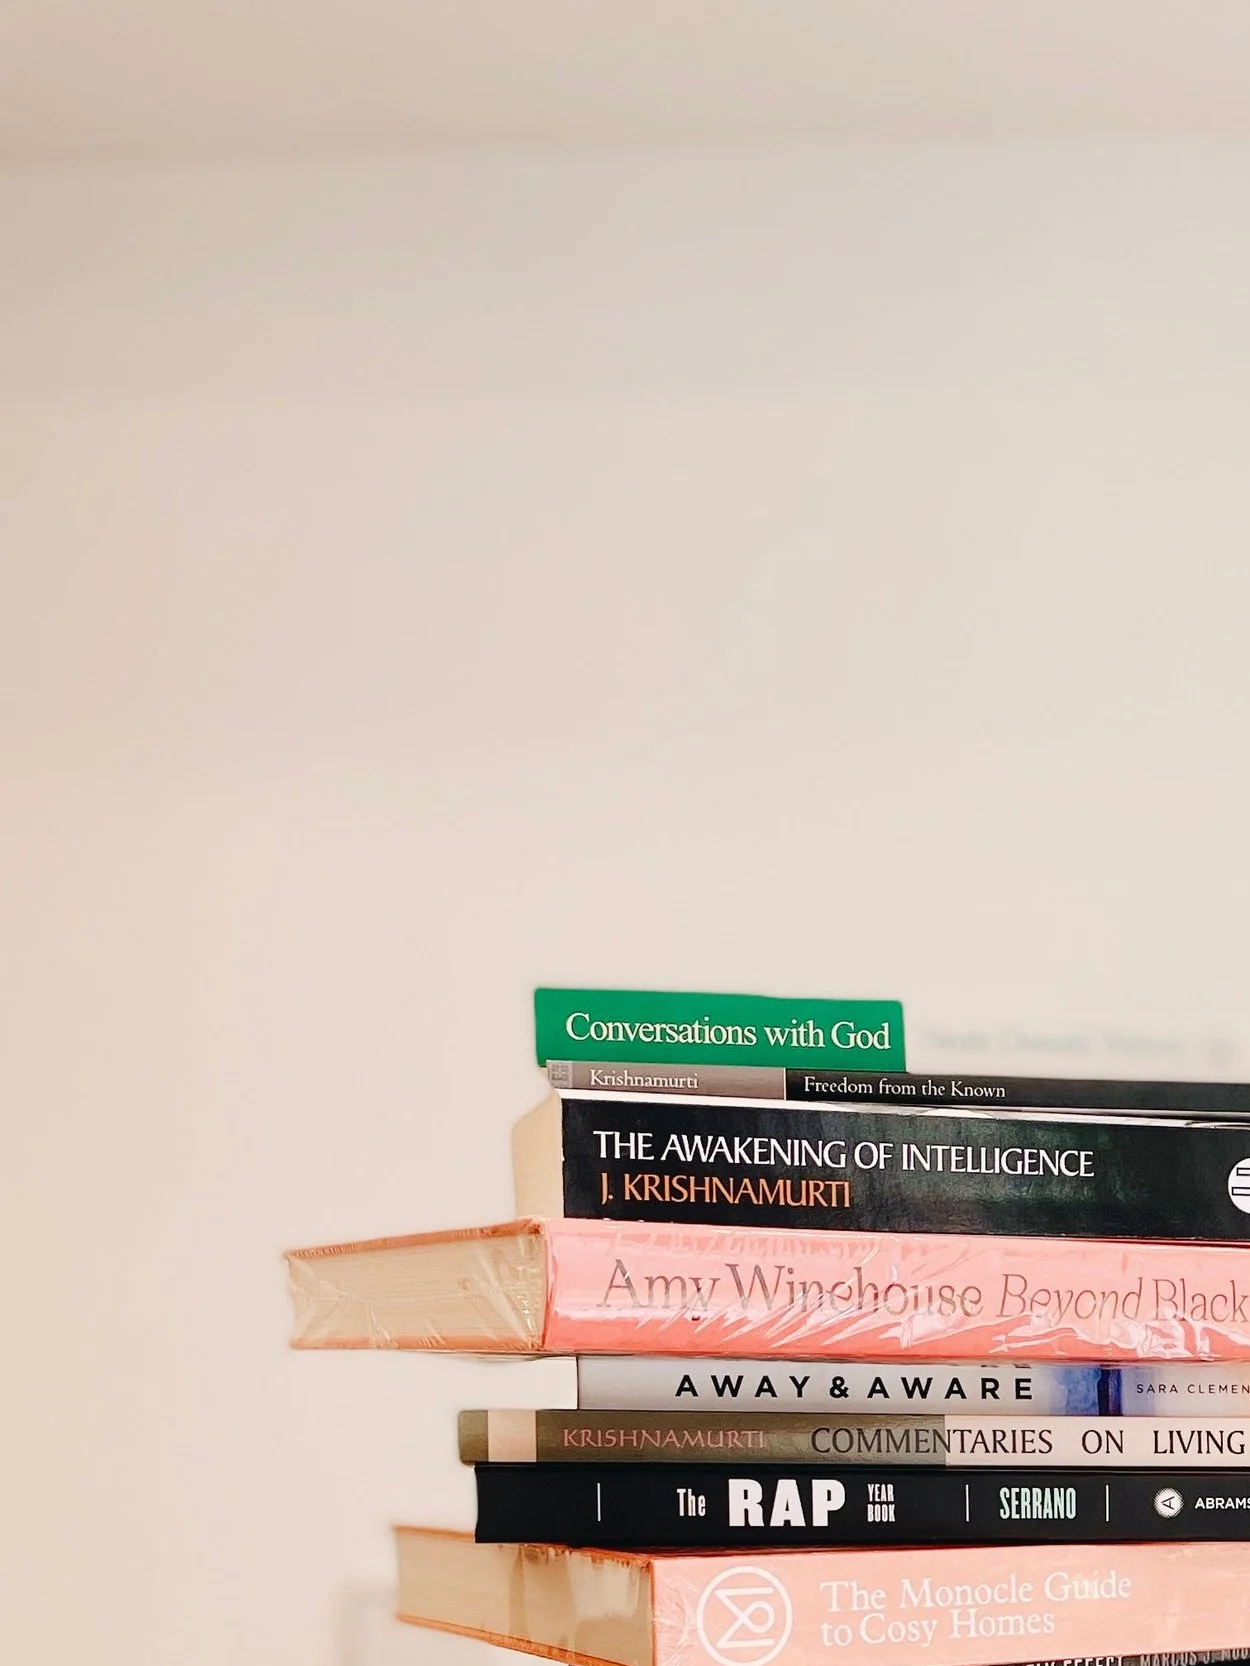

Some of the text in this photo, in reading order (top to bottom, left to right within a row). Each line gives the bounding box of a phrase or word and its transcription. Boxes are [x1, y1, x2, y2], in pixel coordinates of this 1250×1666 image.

[565, 1012, 757, 1047] Conversations
[764, 1019, 826, 1049] with
[830, 1020, 892, 1050] God
[589, 1069, 699, 1090] Krishnamurti
[803, 1075, 1006, 1098] Freedom from the Known
[593, 1131, 1096, 1178] THE AWAKENING OF INTELLIGENCE
[601, 1173, 851, 1207] J. KRISHNAMURTI
[595, 1258, 1250, 1324] Amy Winehouse Beyond Black
[675, 1375, 1033, 1400] AWAY & AWARE
[1136, 1383, 1179, 1394] SARA
[562, 1428, 766, 1449] KRISHNAMURTI
[810, 1427, 1246, 1455] COMMENTARIES ON LIVING
[676, 1478, 846, 1527] The RAP
[867, 1483, 894, 1502] YEAR
[999, 1486, 1077, 1519] SERRANO
[867, 1504, 896, 1523] BOOK
[820, 1569, 1133, 1613] The Monocle Guide
[820, 1608, 1056, 1648] to Cosy Homes
